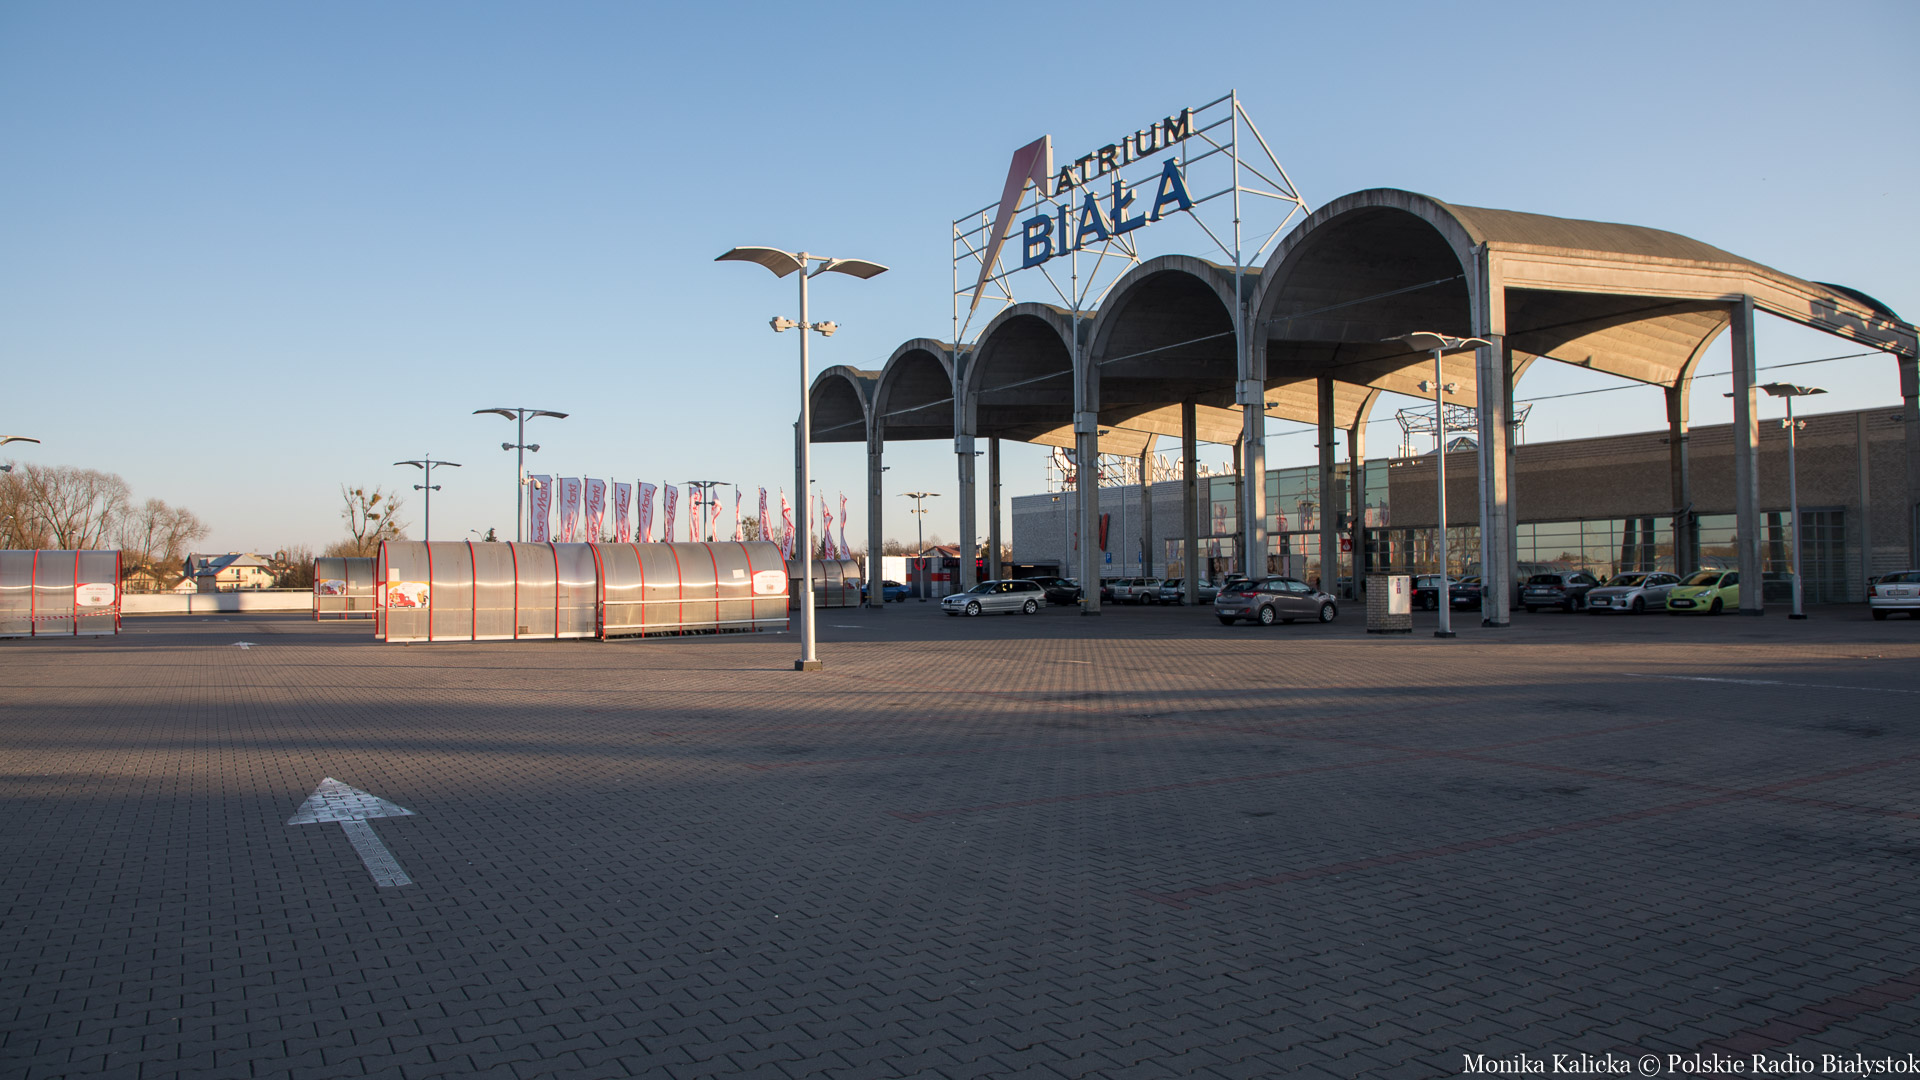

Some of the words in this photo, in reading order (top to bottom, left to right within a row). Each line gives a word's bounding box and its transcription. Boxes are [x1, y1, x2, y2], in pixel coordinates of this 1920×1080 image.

[1055, 107, 1193, 195] ATRIUM
[1022, 156, 1196, 269] BIAŁA
[589, 484, 600, 515] Markt
